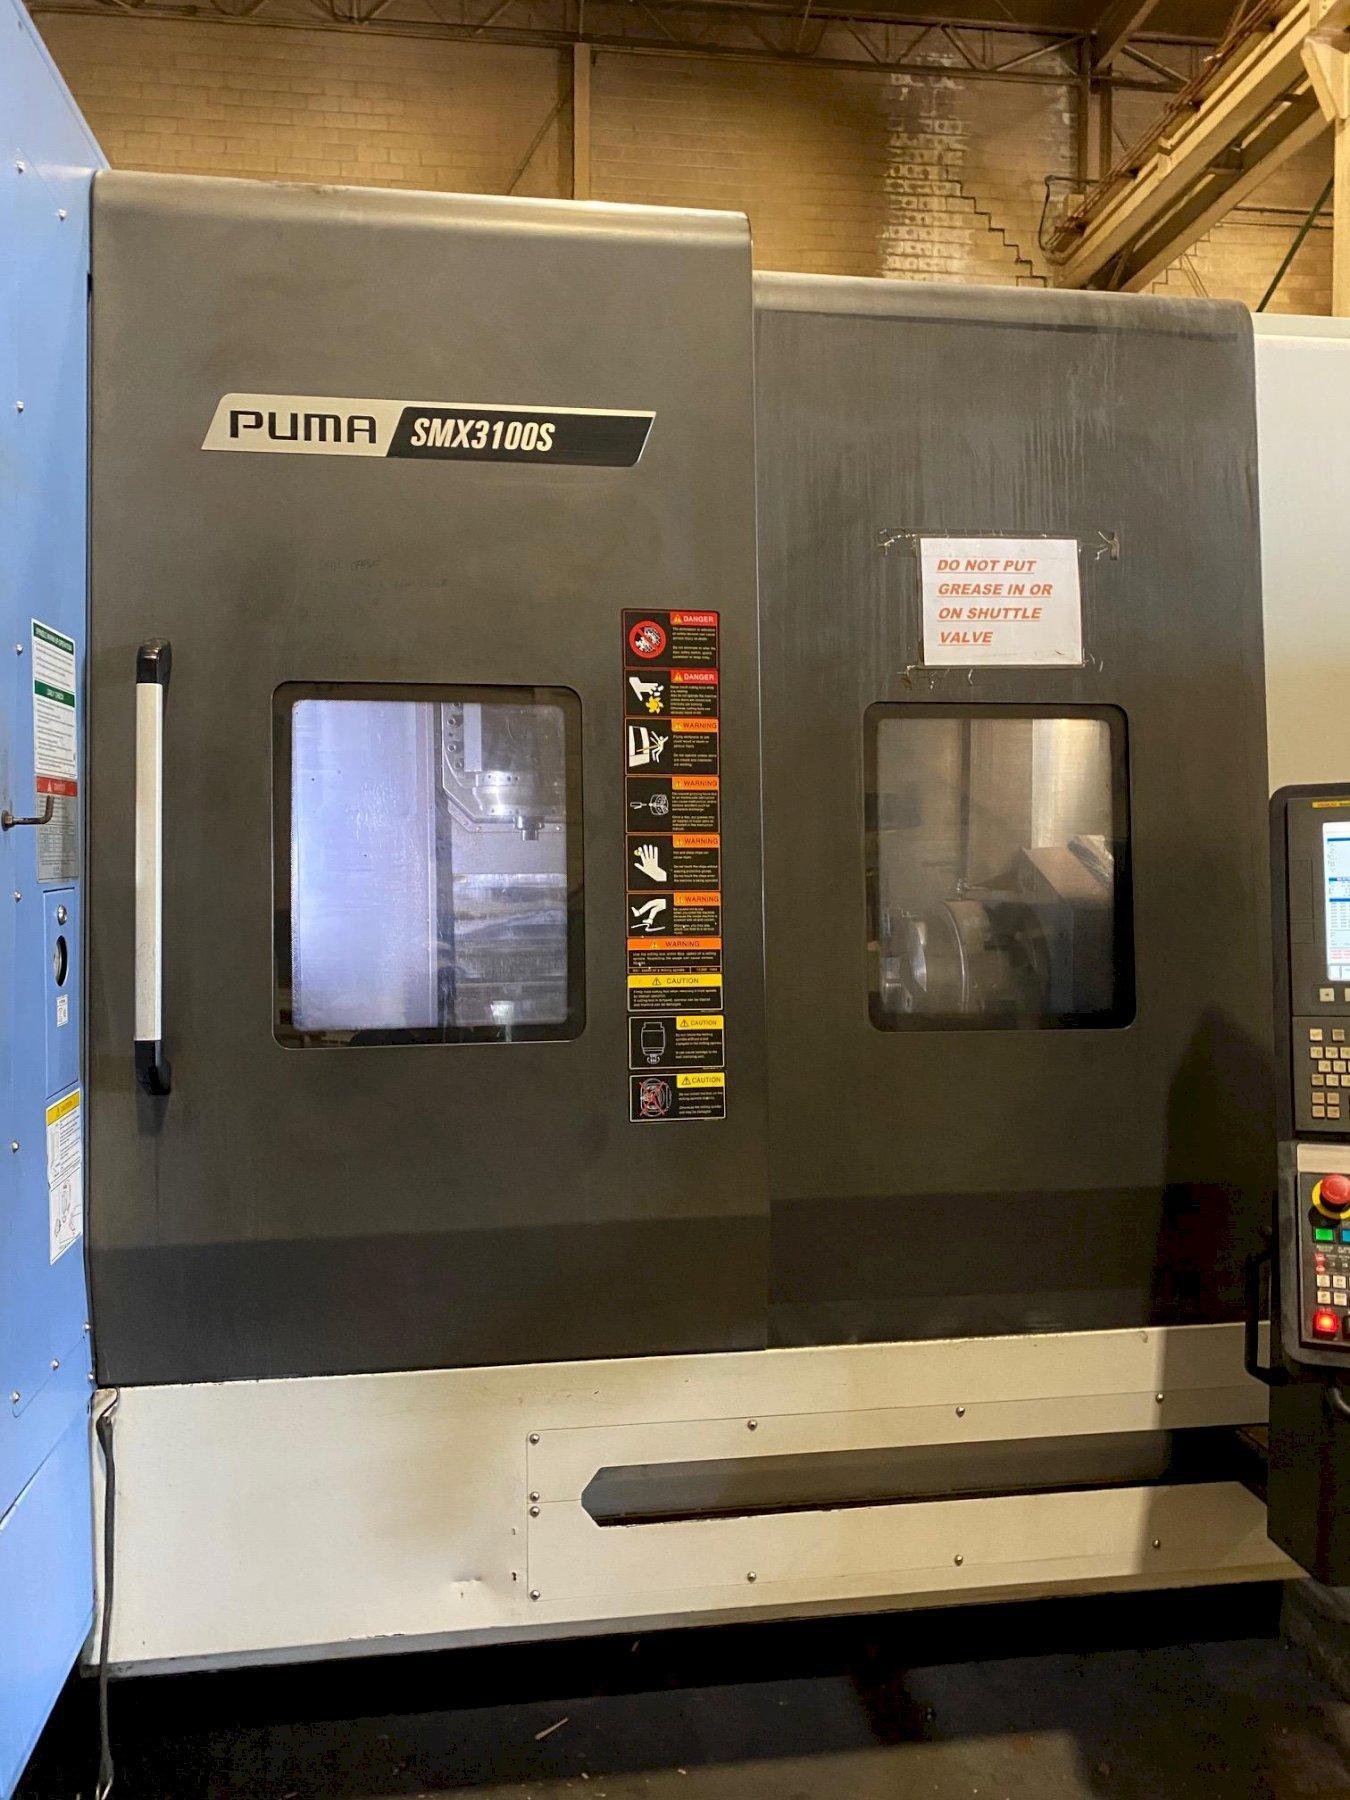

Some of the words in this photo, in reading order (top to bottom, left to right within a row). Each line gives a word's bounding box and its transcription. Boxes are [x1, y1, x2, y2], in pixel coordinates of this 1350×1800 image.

[229, 410, 377, 444] PUMA
[410, 417, 556, 452] SMX3100S
[937, 559, 960, 571] DO
[964, 560, 1000, 572] NOT
[1003, 560, 1037, 572] PUT
[938, 583, 1003, 596] GREASE
[1007, 583, 1025, 596] IN
[1029, 583, 1054, 596] OR
[683, 615, 714, 623] DANGER
[938, 607, 963, 619] ON
[966, 607, 1042, 619] SHUTTLE
[939, 631, 994, 644] VALVE
[683, 673, 715, 681] DANGER
[684, 837, 719, 845] WARNING
[685, 895, 719, 903] WARNING
